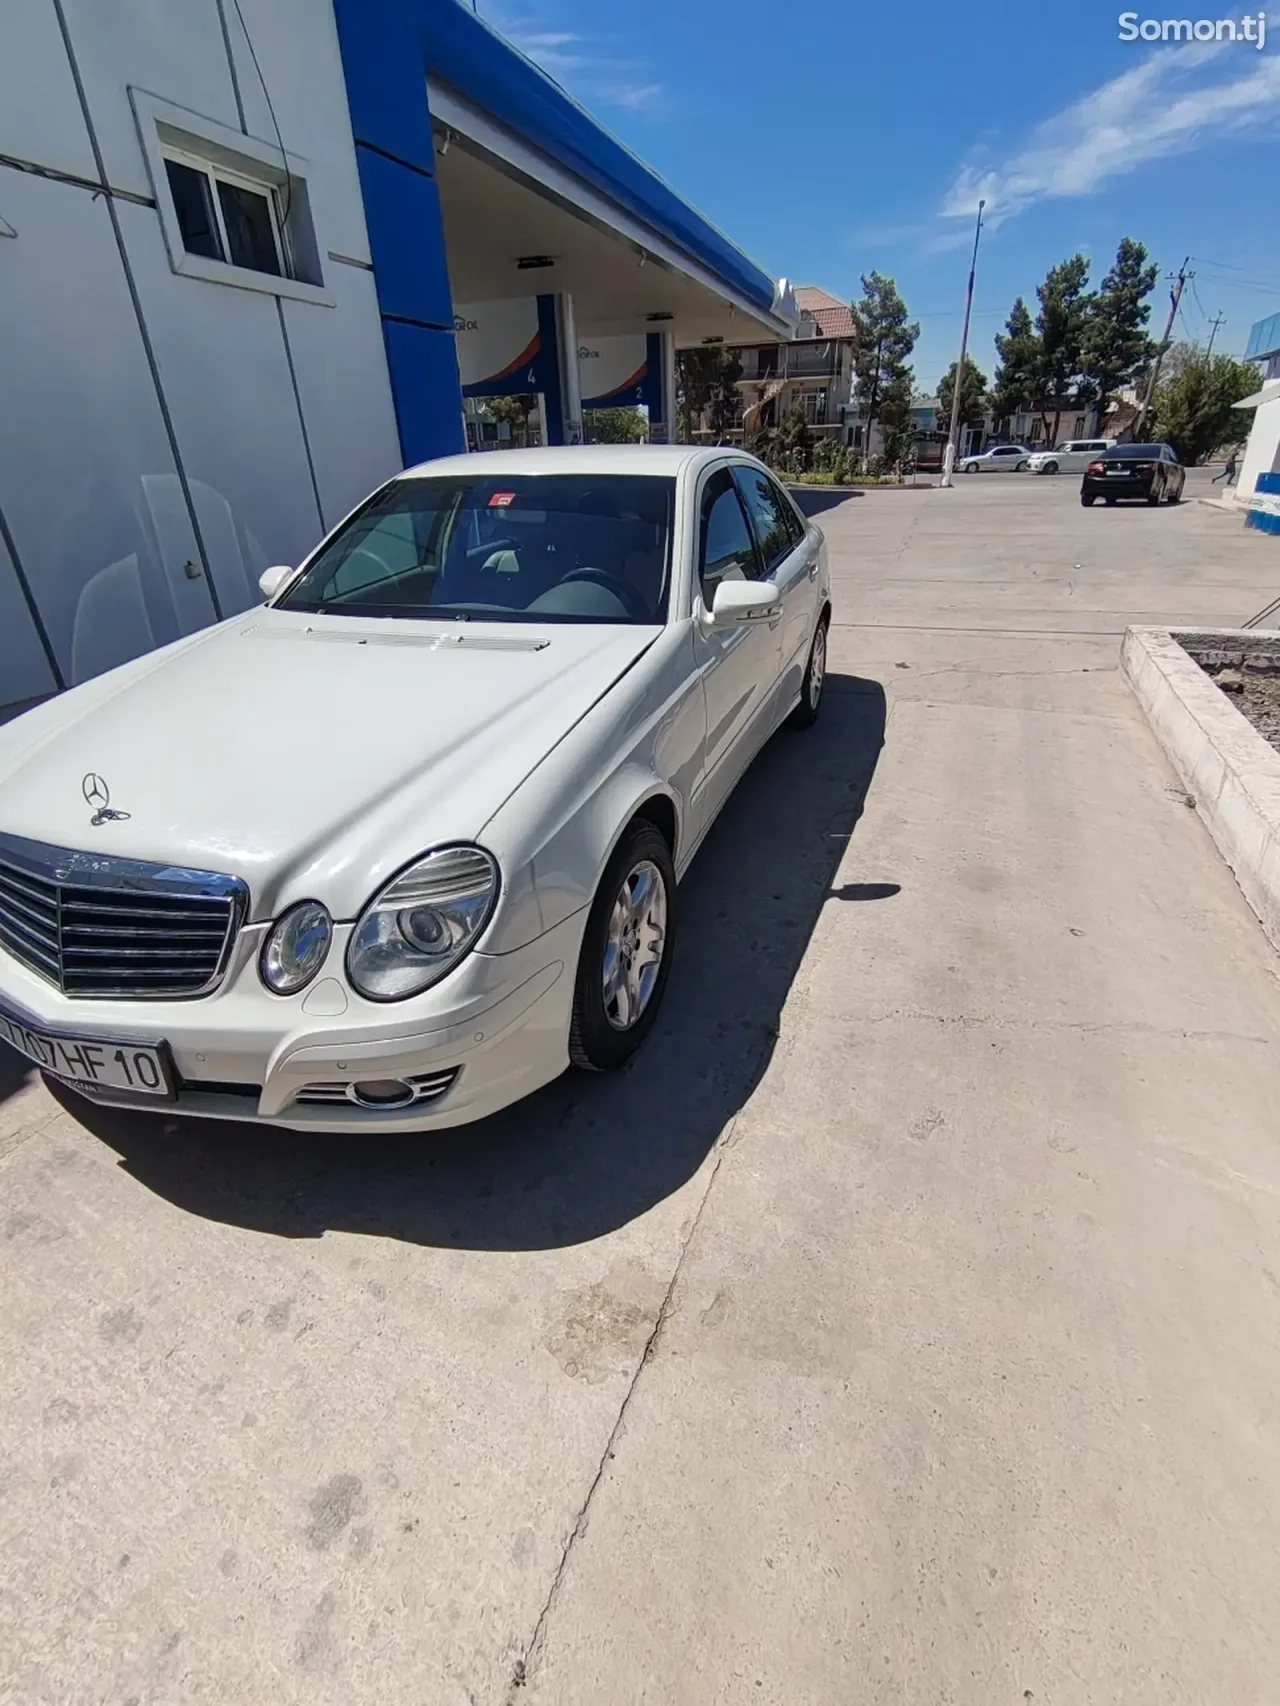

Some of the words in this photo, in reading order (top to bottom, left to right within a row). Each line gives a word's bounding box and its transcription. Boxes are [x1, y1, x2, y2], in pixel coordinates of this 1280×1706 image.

[527, 368, 536, 384] 4
[635, 387, 643, 399] 2
[113, 1050, 160, 1088] 10
